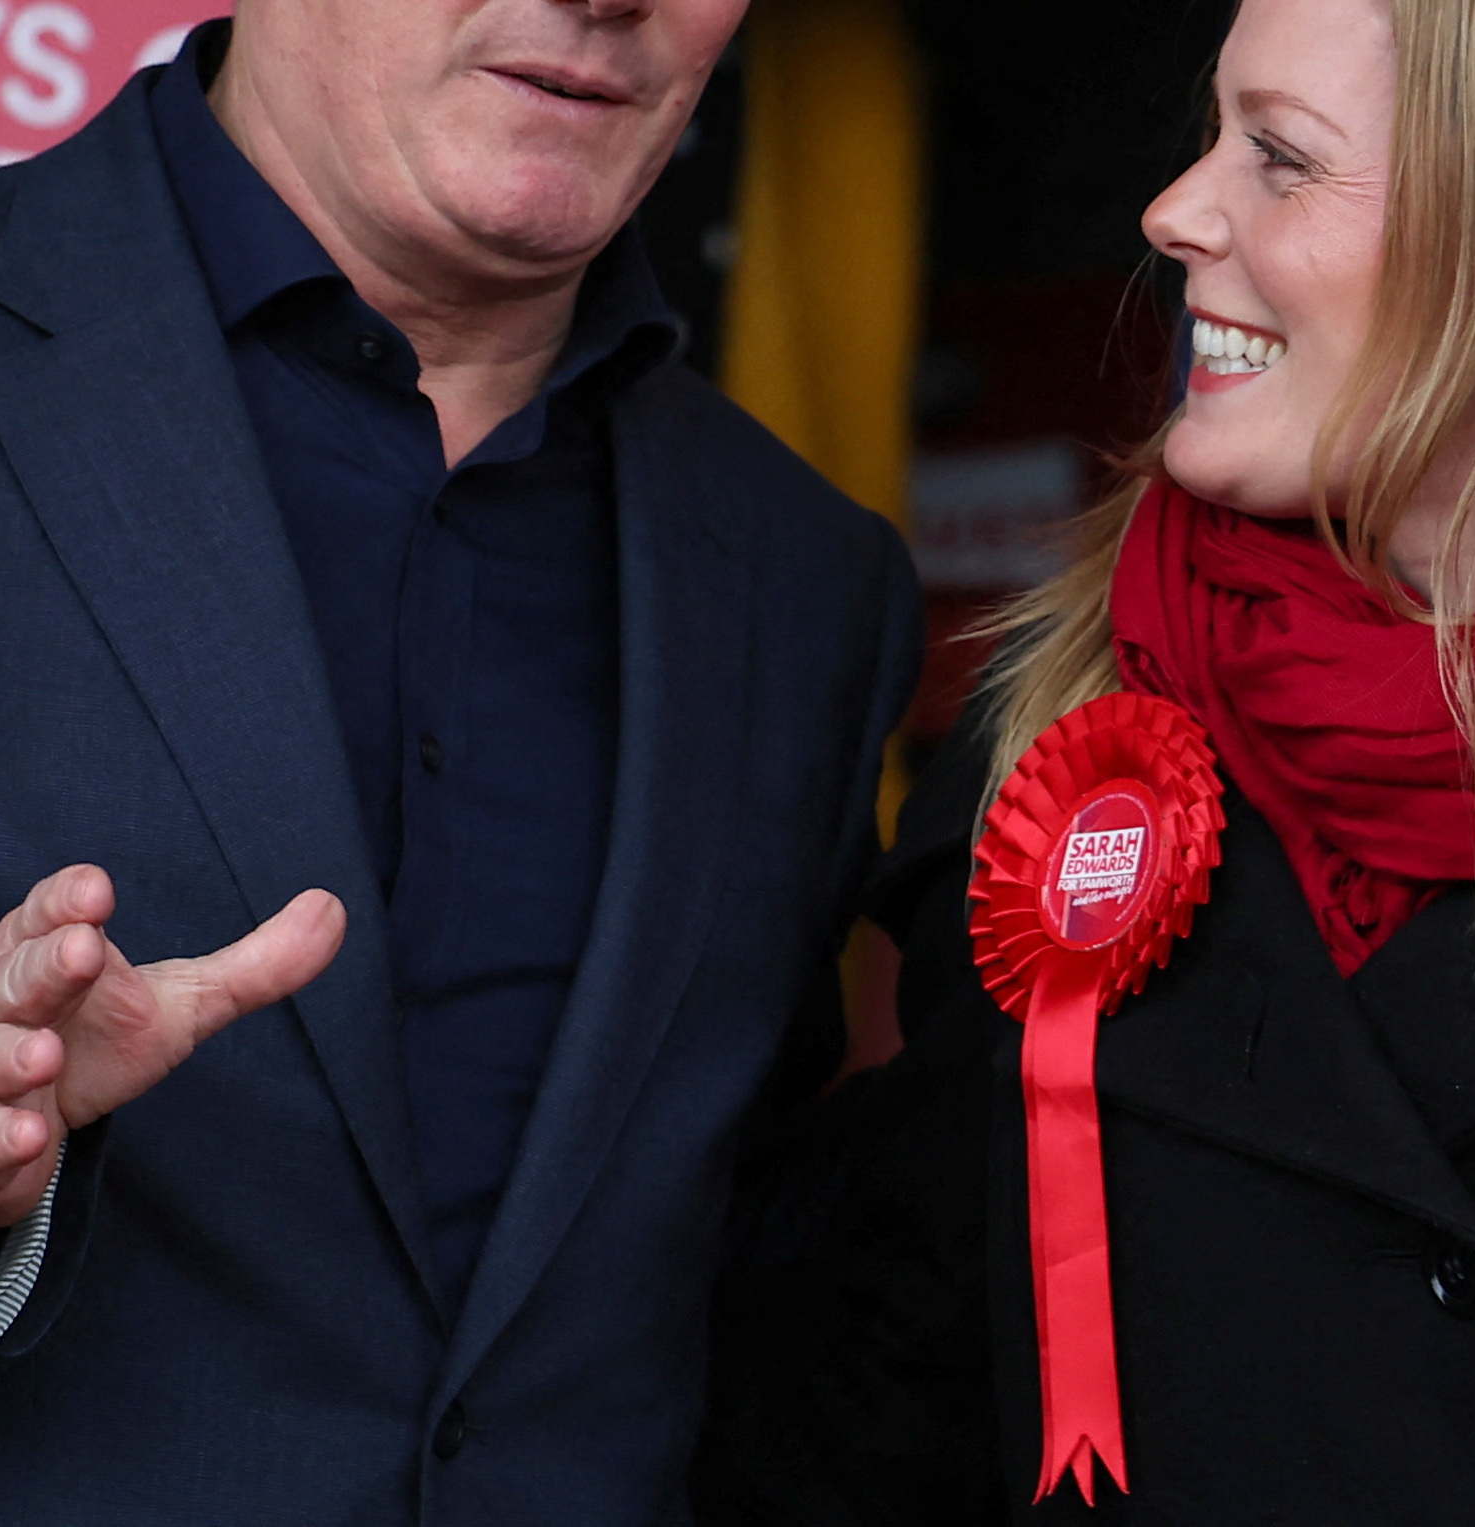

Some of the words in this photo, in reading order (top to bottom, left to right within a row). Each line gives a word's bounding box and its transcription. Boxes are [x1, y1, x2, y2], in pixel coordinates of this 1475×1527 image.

[1069, 830, 1140, 859] SARAH
[1065, 853, 1135, 876] EDWARDS
[1056, 878, 1078, 892] FOR
[1079, 874, 1136, 891] TAMWORTH
